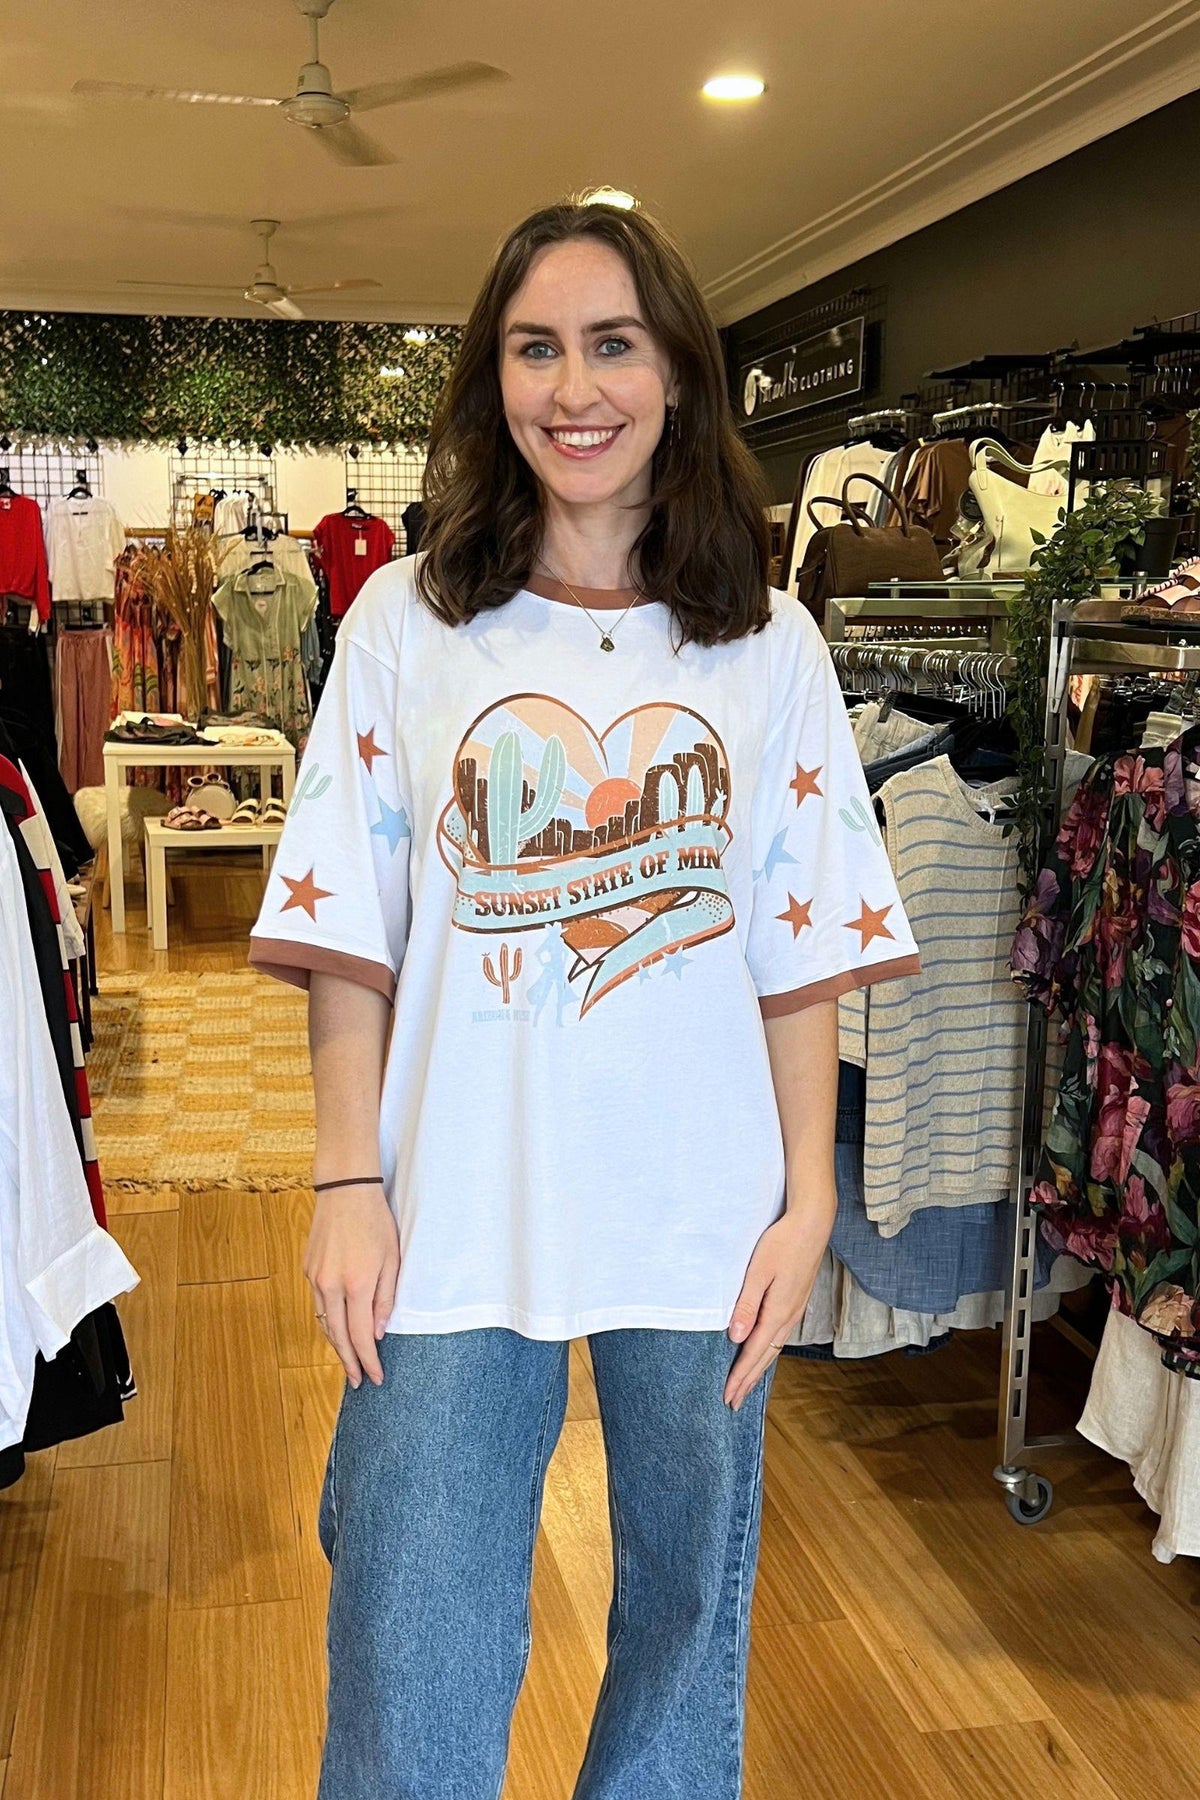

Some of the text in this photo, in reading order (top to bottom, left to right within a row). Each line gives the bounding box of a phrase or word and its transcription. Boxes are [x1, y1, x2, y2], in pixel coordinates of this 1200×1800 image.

[800, 359, 854, 391] CLOTHING
[474, 888, 561, 916] SUNSET
[567, 862, 633, 905] STATE
[640, 851, 669, 879] OF
